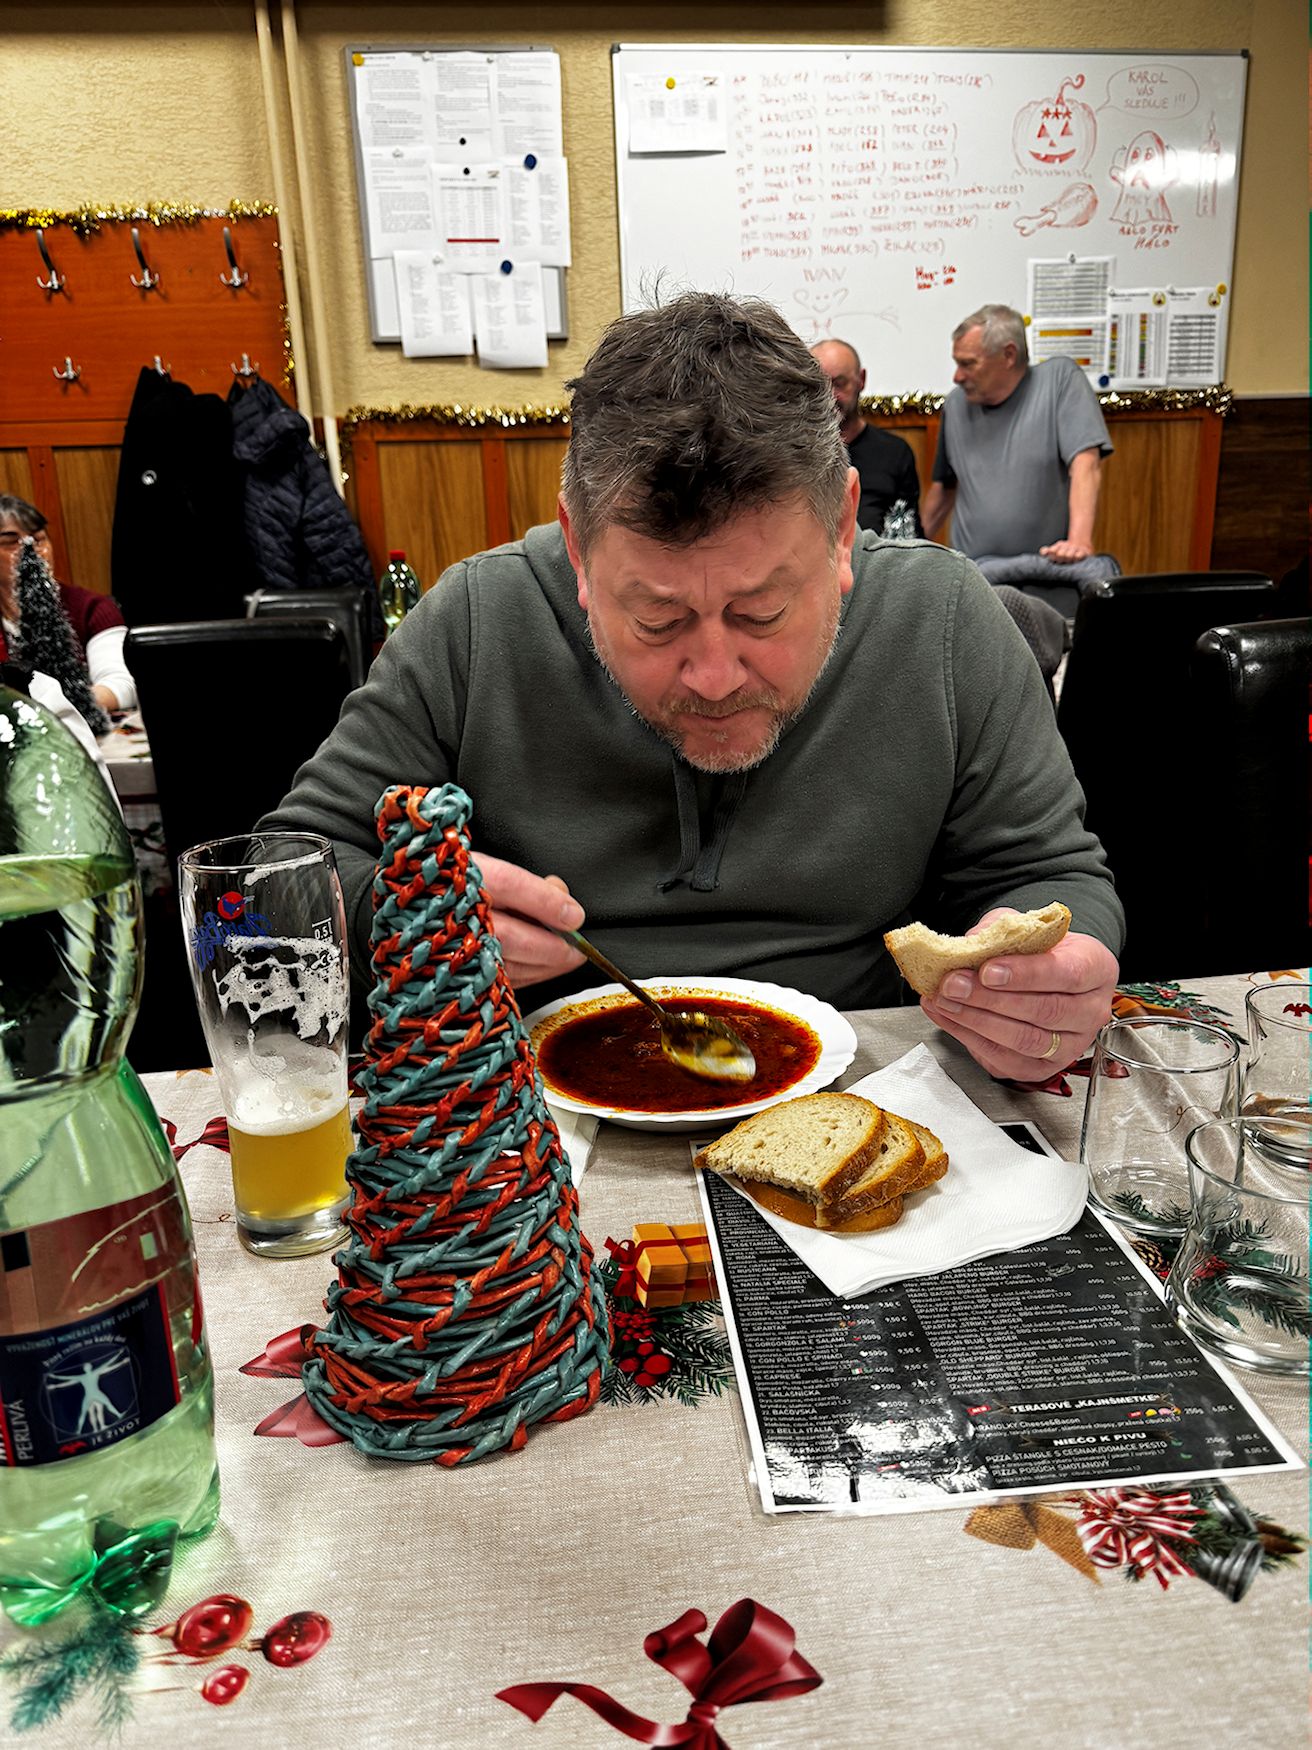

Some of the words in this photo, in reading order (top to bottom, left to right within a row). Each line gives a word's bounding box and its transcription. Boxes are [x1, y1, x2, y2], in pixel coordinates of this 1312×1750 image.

[1128, 70, 1168, 83] KAROL
[754, 1339, 806, 1347] GORGONZOLA
[1005, 1351, 1038, 1359] BURGER
[763, 1372, 801, 1381] CAPRESE
[946, 1374, 983, 1382] SPARTAK
[1053, 1366, 1087, 1374] BURGER
[1009, 1400, 1072, 1412] TERASOVÉ
[1019, 1417, 1080, 1427] Cheese&Bacon
[91, 1436, 103, 1447] JE
[104, 1418, 142, 1440] ŽIVOT
[776, 1426, 804, 1435] BELLA
[805, 1425, 833, 1433] ITALIA
[1052, 1435, 1097, 1446] NIEČO
[1113, 1432, 1147, 1441] PIVU
[985, 1454, 1011, 1462] PIZZA
[1138, 1441, 1168, 1449] PESTO
